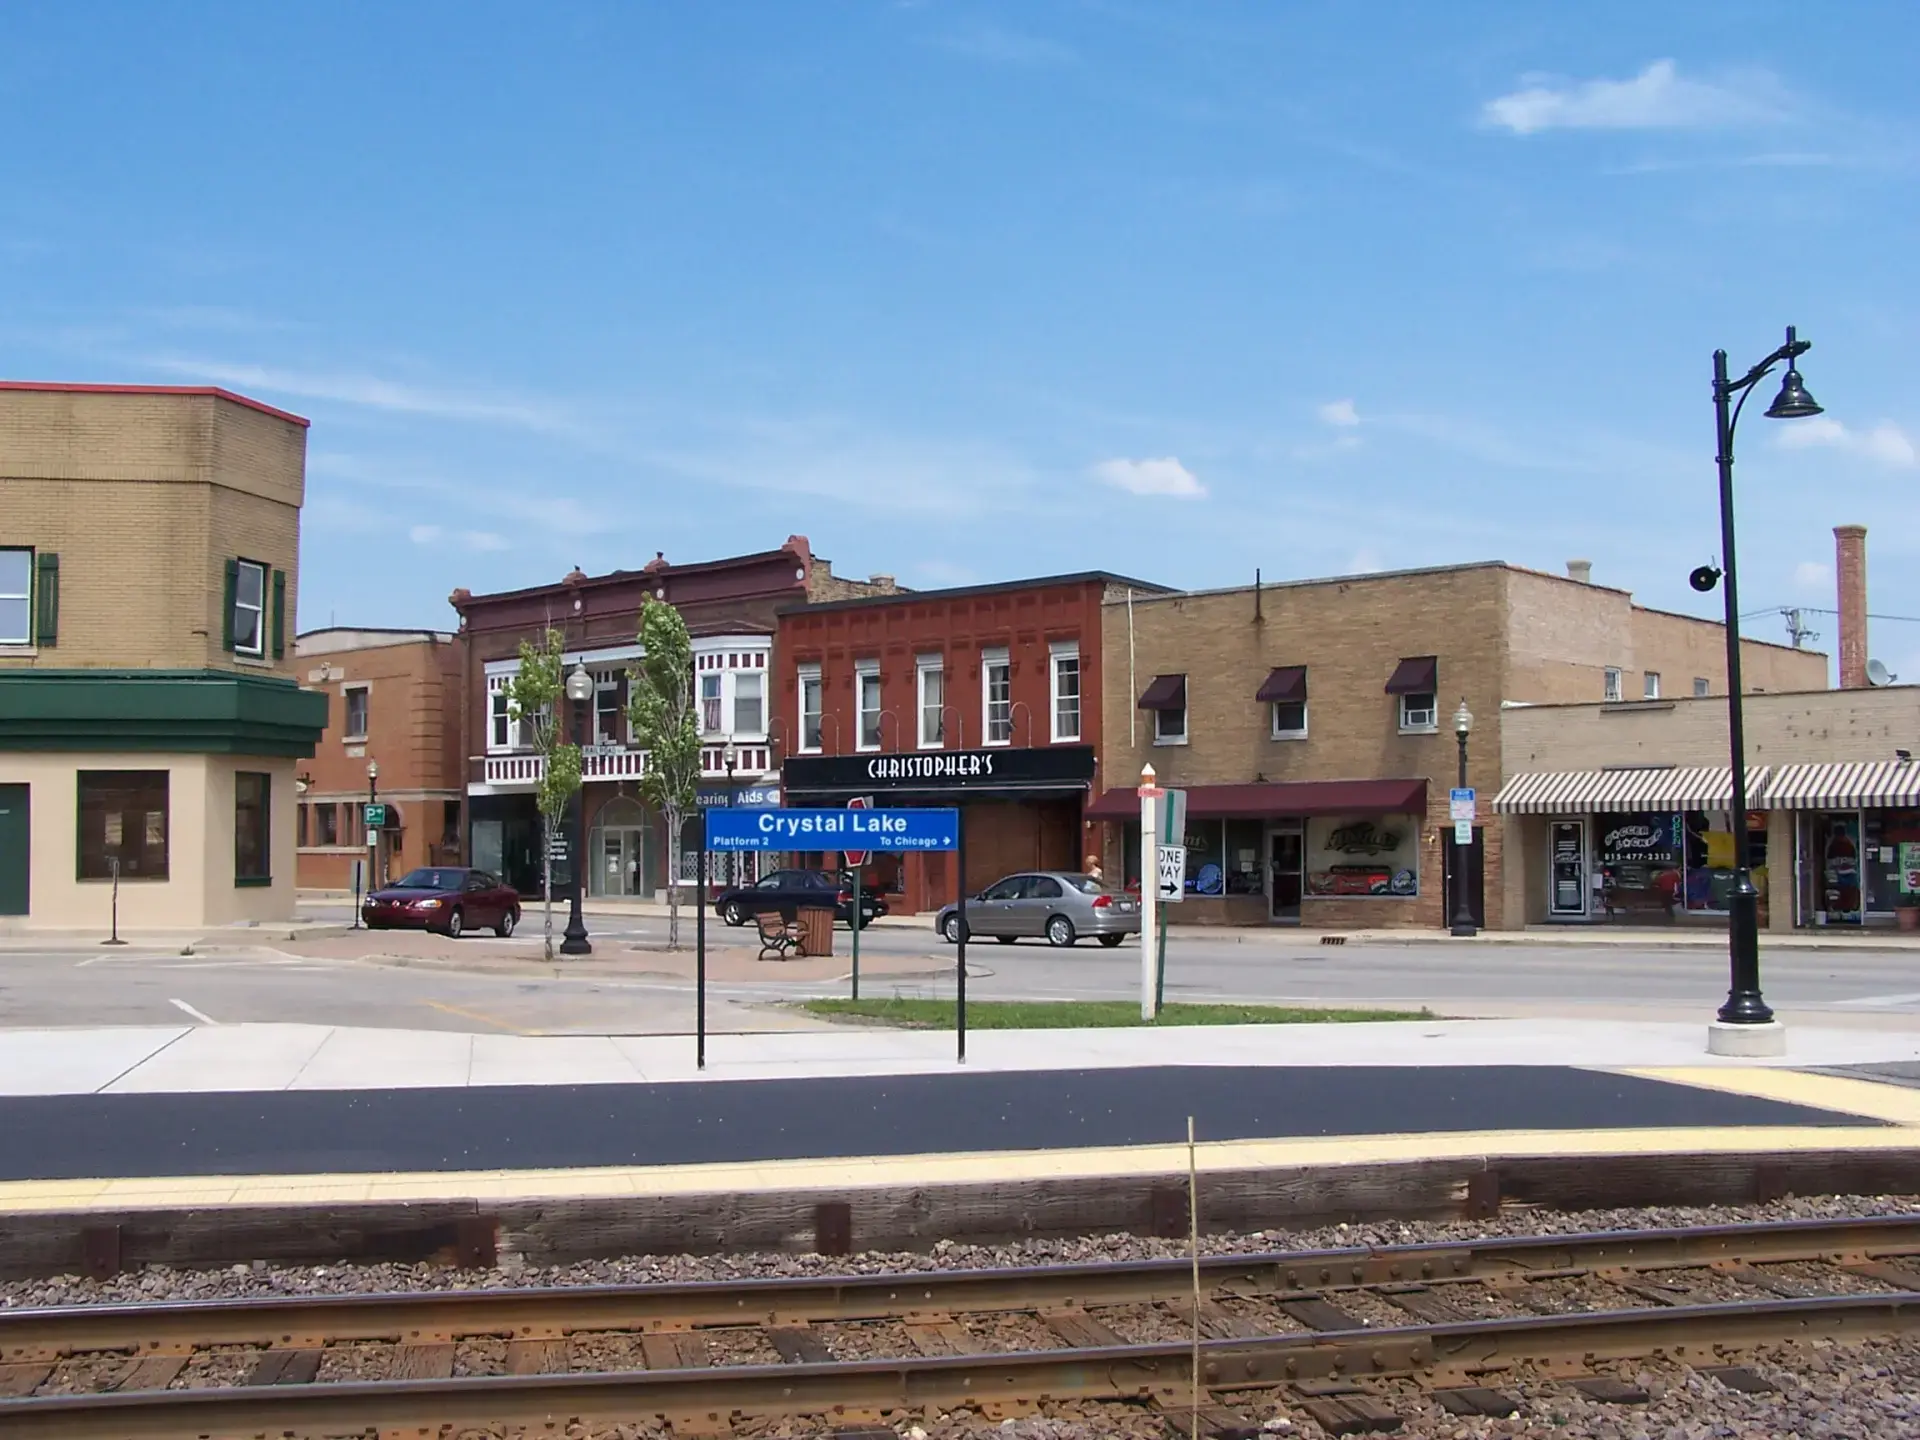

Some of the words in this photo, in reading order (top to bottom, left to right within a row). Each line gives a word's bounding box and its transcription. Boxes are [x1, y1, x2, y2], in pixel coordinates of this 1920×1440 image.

[868, 754, 993, 778] CHRISTOPHER'S
[696, 793, 728, 807] earing
[738, 791, 763, 804] Aids
[758, 813, 845, 836] Crystal
[853, 814, 907, 832] Lake
[713, 836, 760, 846] Platform
[762, 837, 770, 846] 2
[880, 836, 892, 846] To
[894, 836, 938, 848] Chicago
